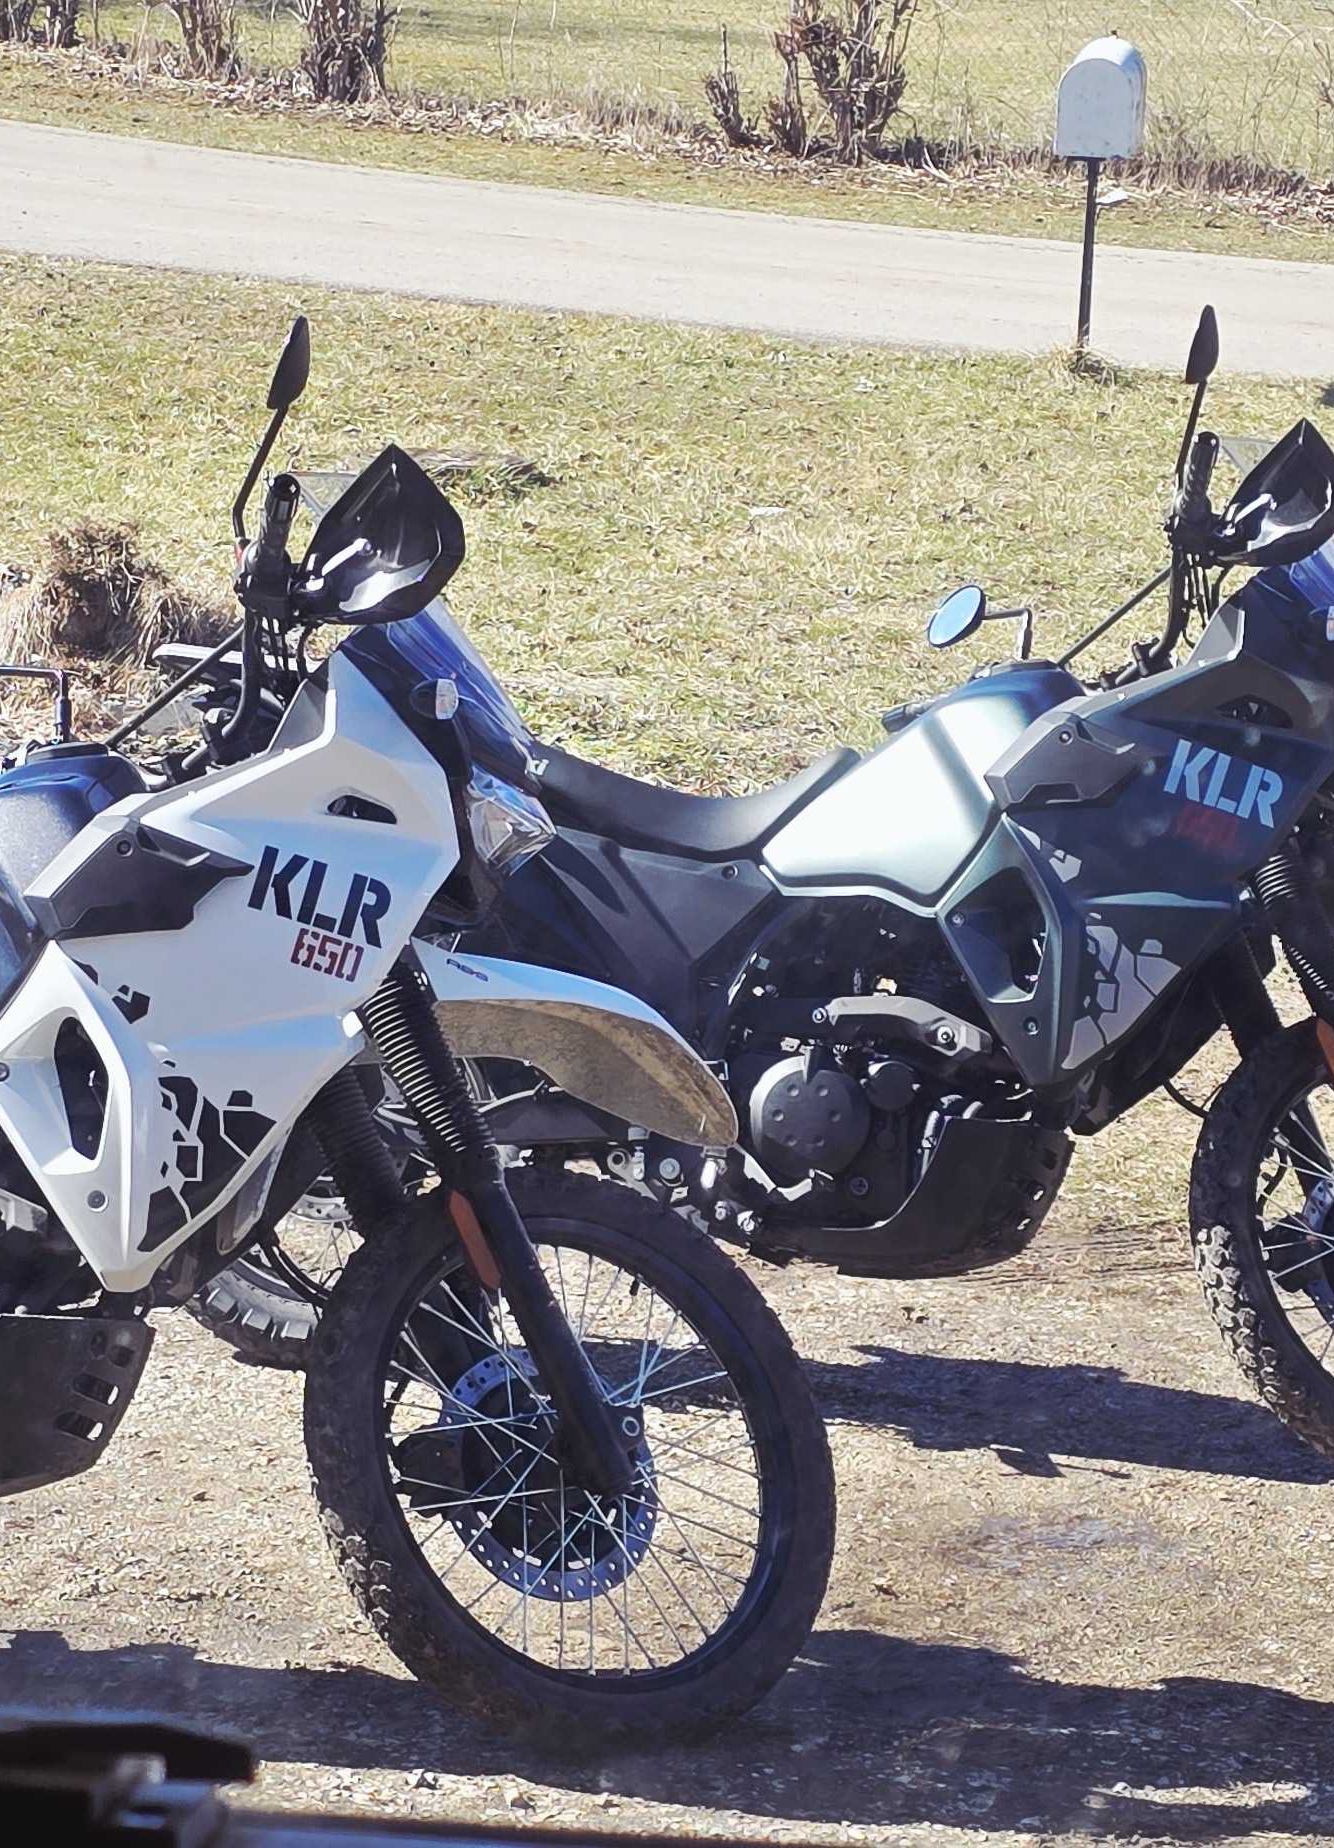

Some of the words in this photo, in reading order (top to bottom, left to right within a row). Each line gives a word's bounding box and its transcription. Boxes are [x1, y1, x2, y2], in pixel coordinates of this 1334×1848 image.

[1164, 739, 1283, 828] KLR
[248, 845, 392, 948] KLR
[290, 928, 364, 982] 650
